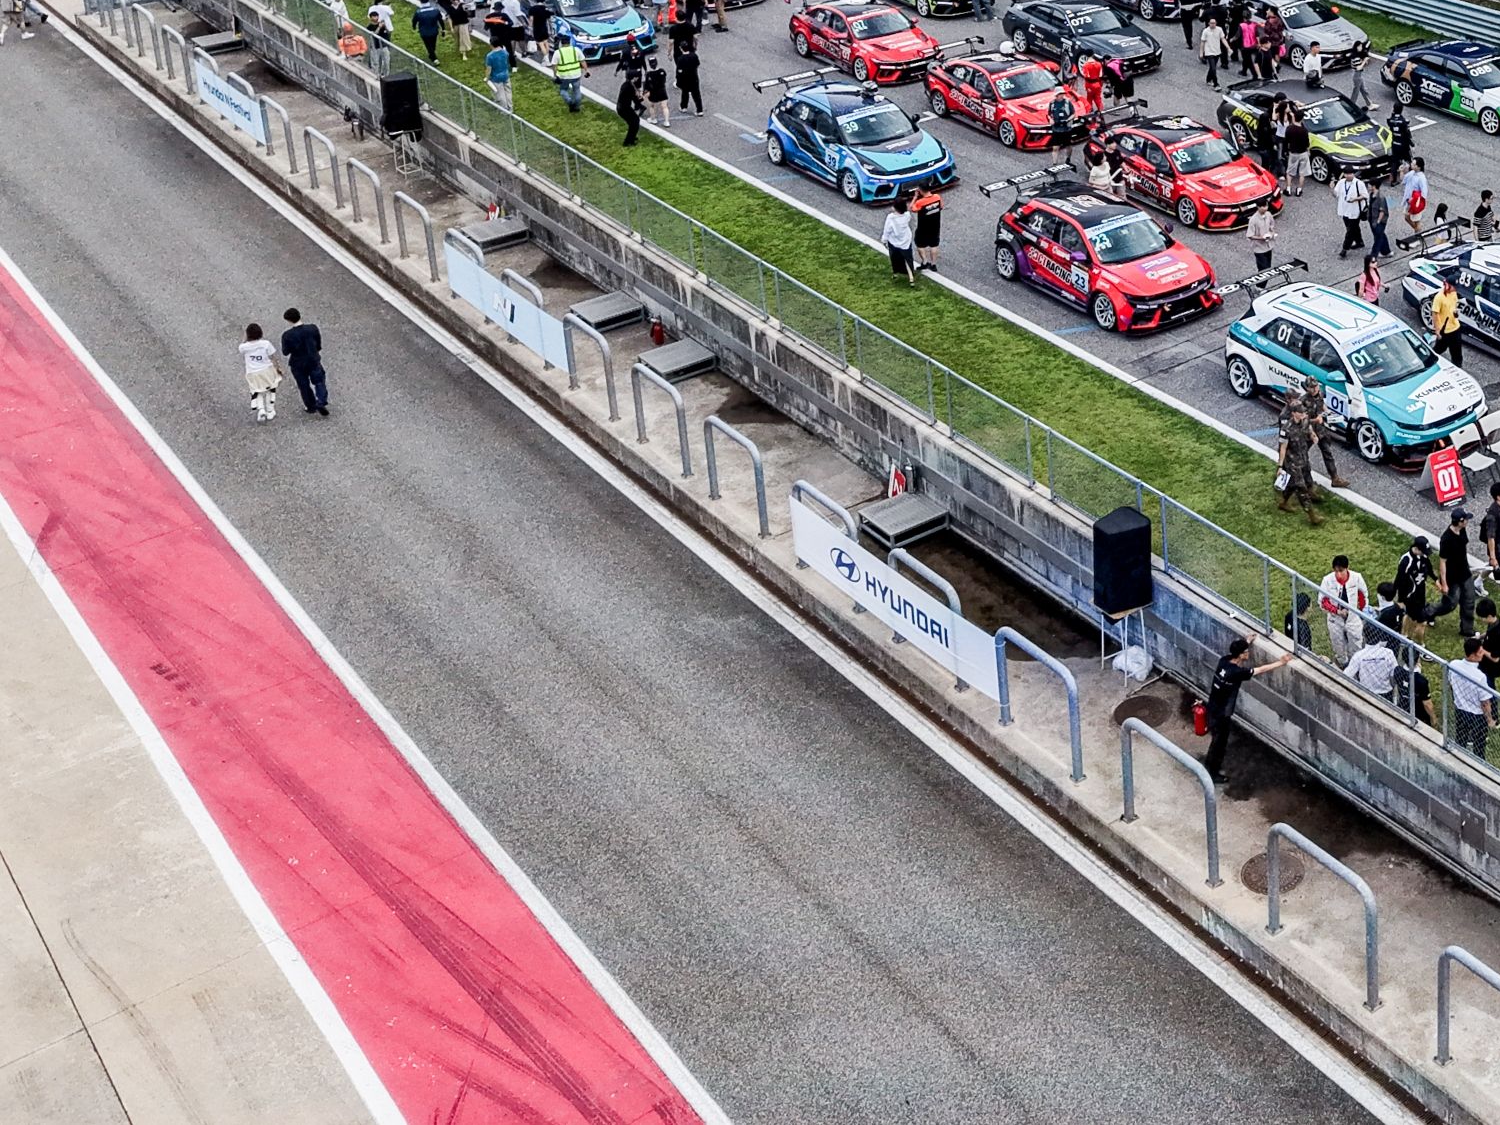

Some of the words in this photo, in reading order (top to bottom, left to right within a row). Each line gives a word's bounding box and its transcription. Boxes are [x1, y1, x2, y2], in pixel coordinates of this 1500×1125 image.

[1071, 15, 1092, 27] 073
[842, 121, 859, 134] 39
[1161, 185, 1172, 198] 16
[1074, 273, 1086, 289] 23
[1459, 271, 1472, 287] 83
[1277, 324, 1293, 345] 01
[1351, 350, 1373, 368] 01
[1268, 364, 1300, 384] KUMHO
[1415, 380, 1451, 401] KUMHO
[1330, 396, 1344, 413] 01
[1437, 465, 1459, 493] 01
[865, 571, 950, 649] HYUNDAI
